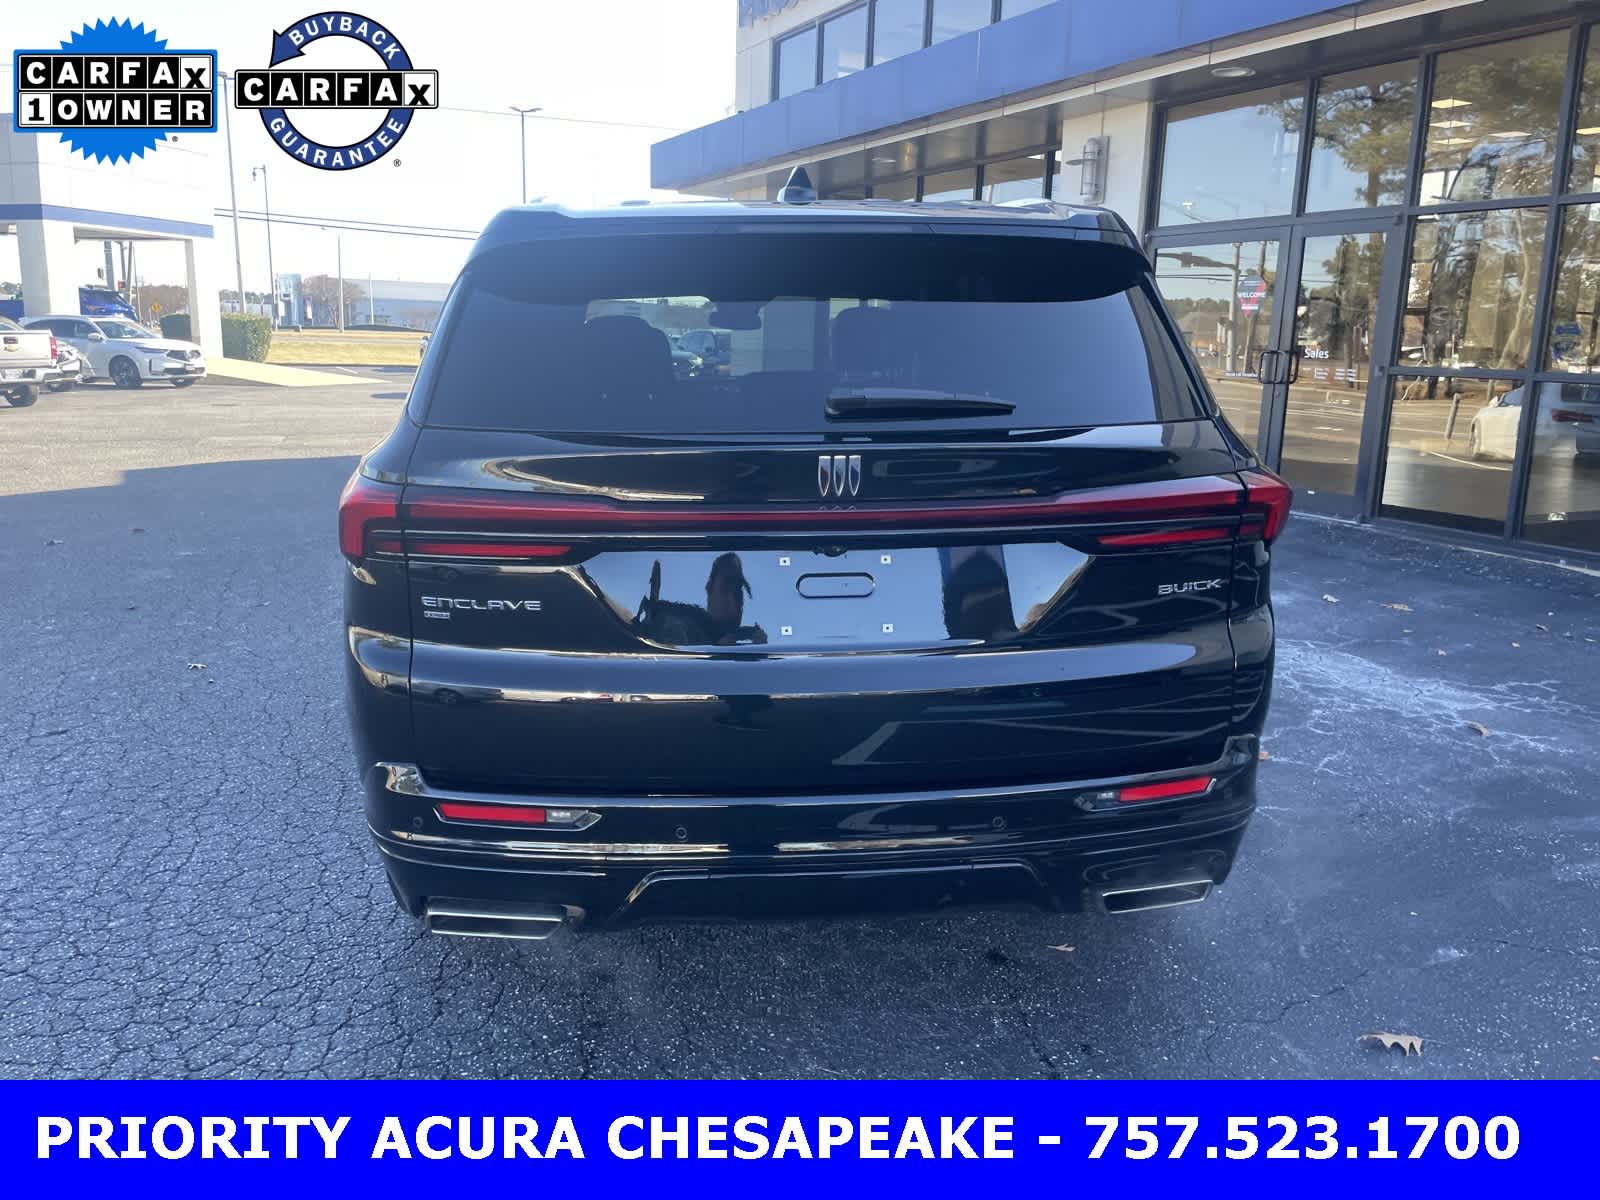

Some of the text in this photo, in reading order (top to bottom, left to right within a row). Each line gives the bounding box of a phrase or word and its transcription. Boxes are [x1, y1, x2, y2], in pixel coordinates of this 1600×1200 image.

[1303, 348, 1329, 359] Sales
[1158, 579, 1222, 595] BUICK
[421, 596, 542, 611] ENCLAVE
